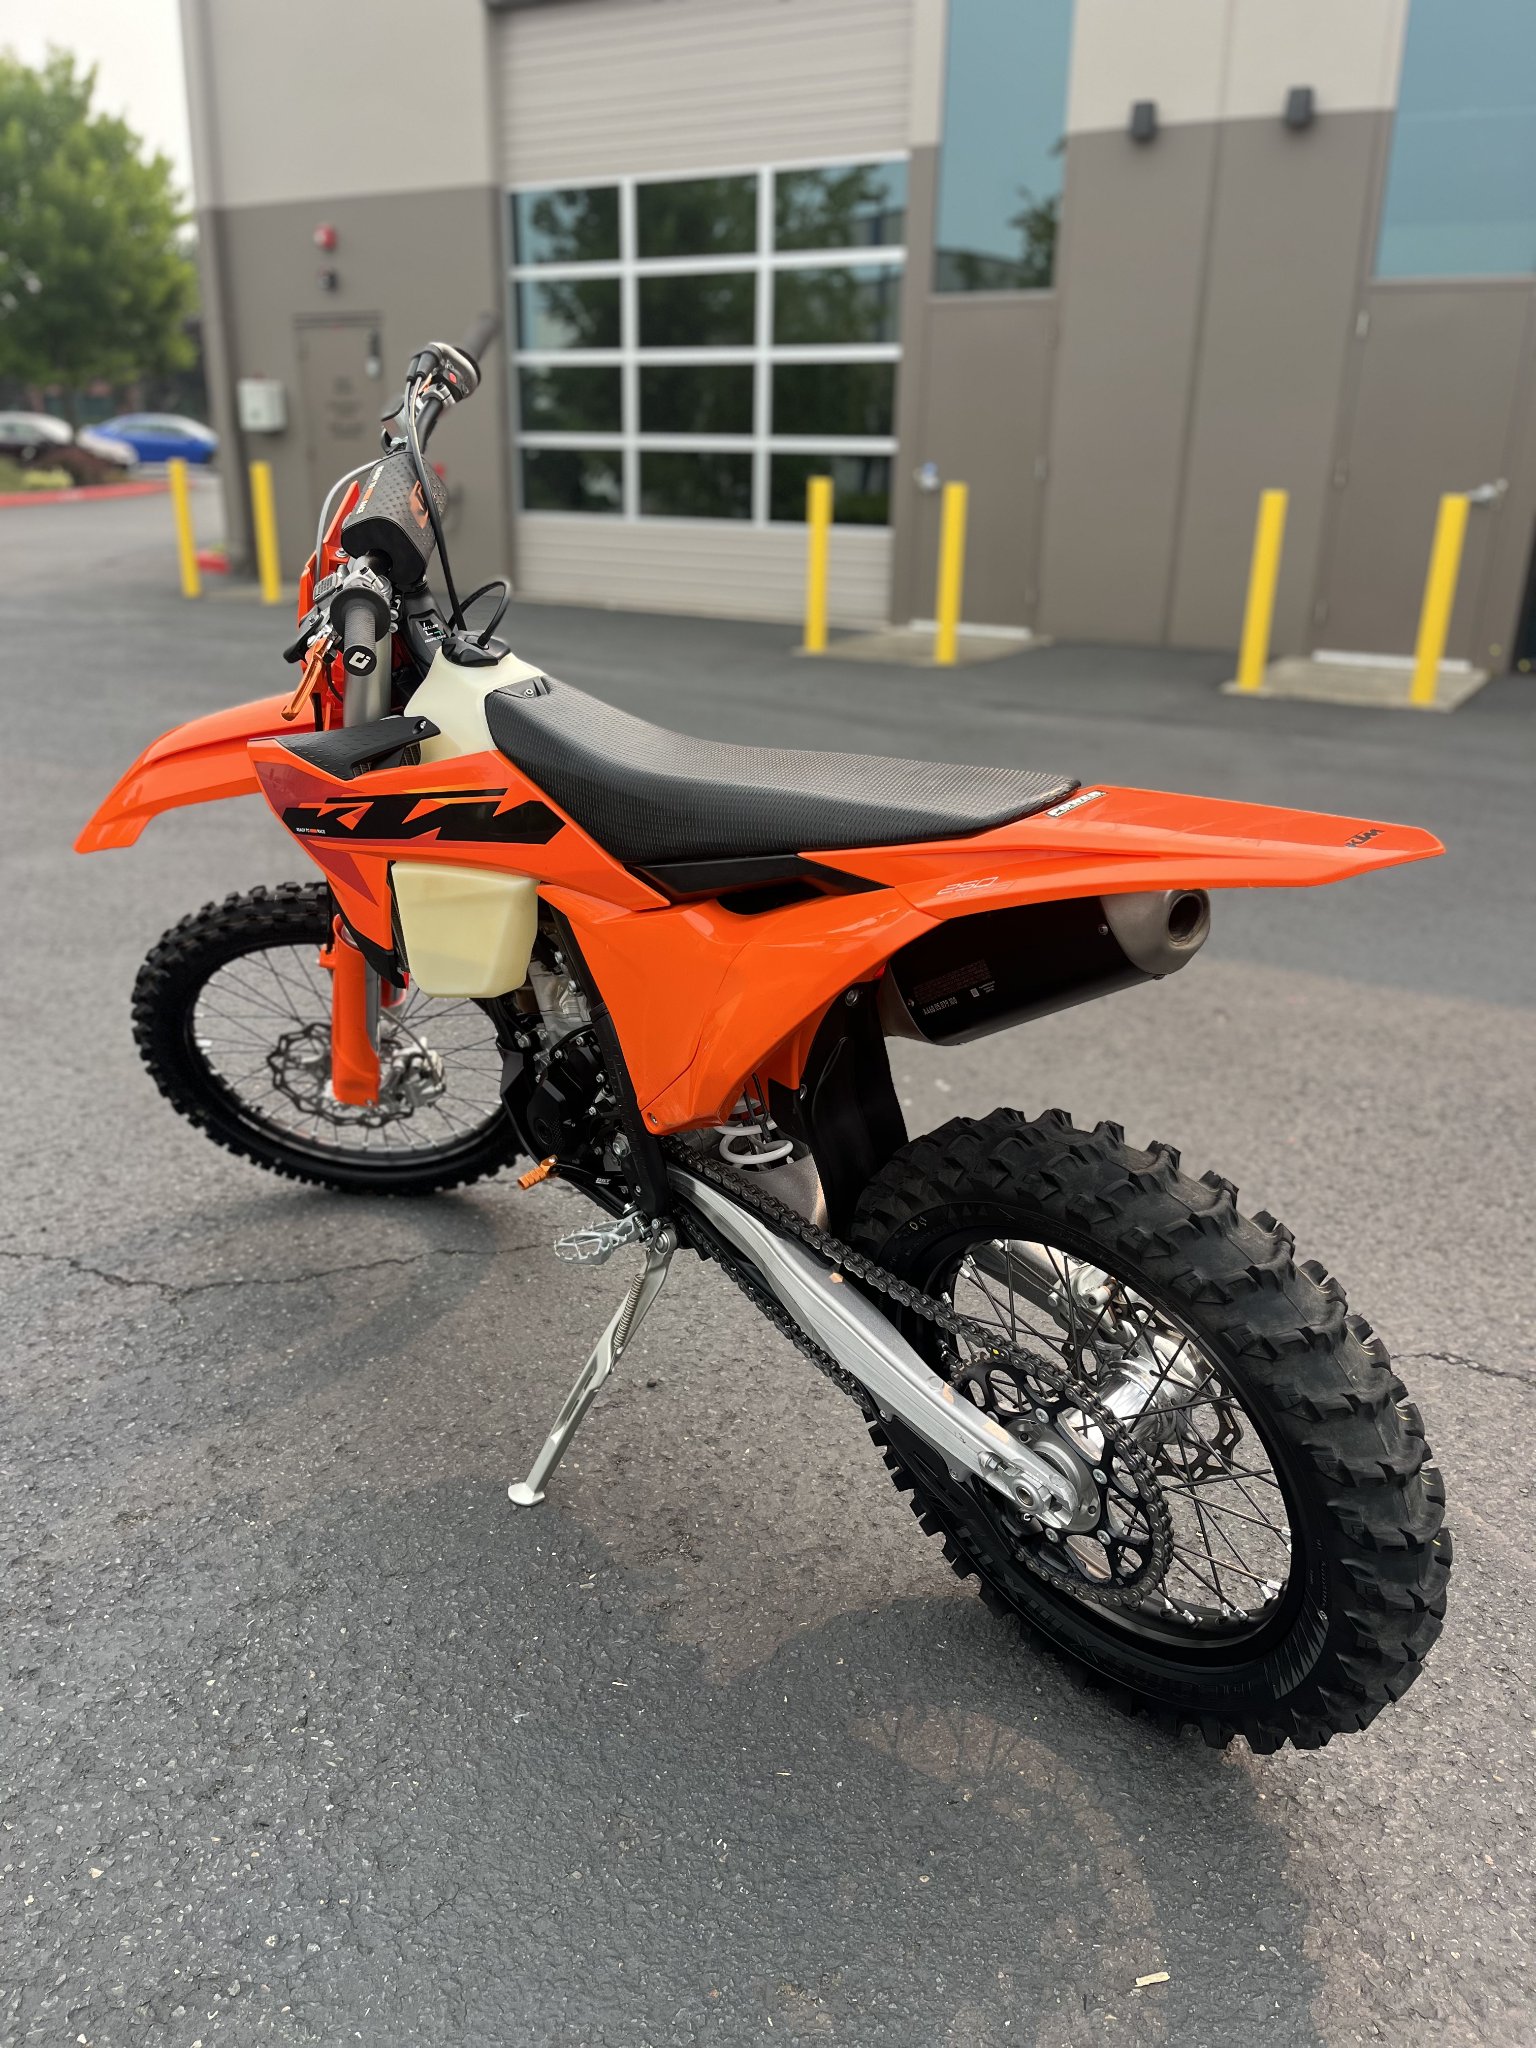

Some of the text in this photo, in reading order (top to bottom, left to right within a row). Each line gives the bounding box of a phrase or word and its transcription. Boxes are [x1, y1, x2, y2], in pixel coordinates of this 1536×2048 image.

[282, 788, 566, 845] KTM
[1344, 829, 1385, 848] KTM
[936, 876, 999, 896] 250
